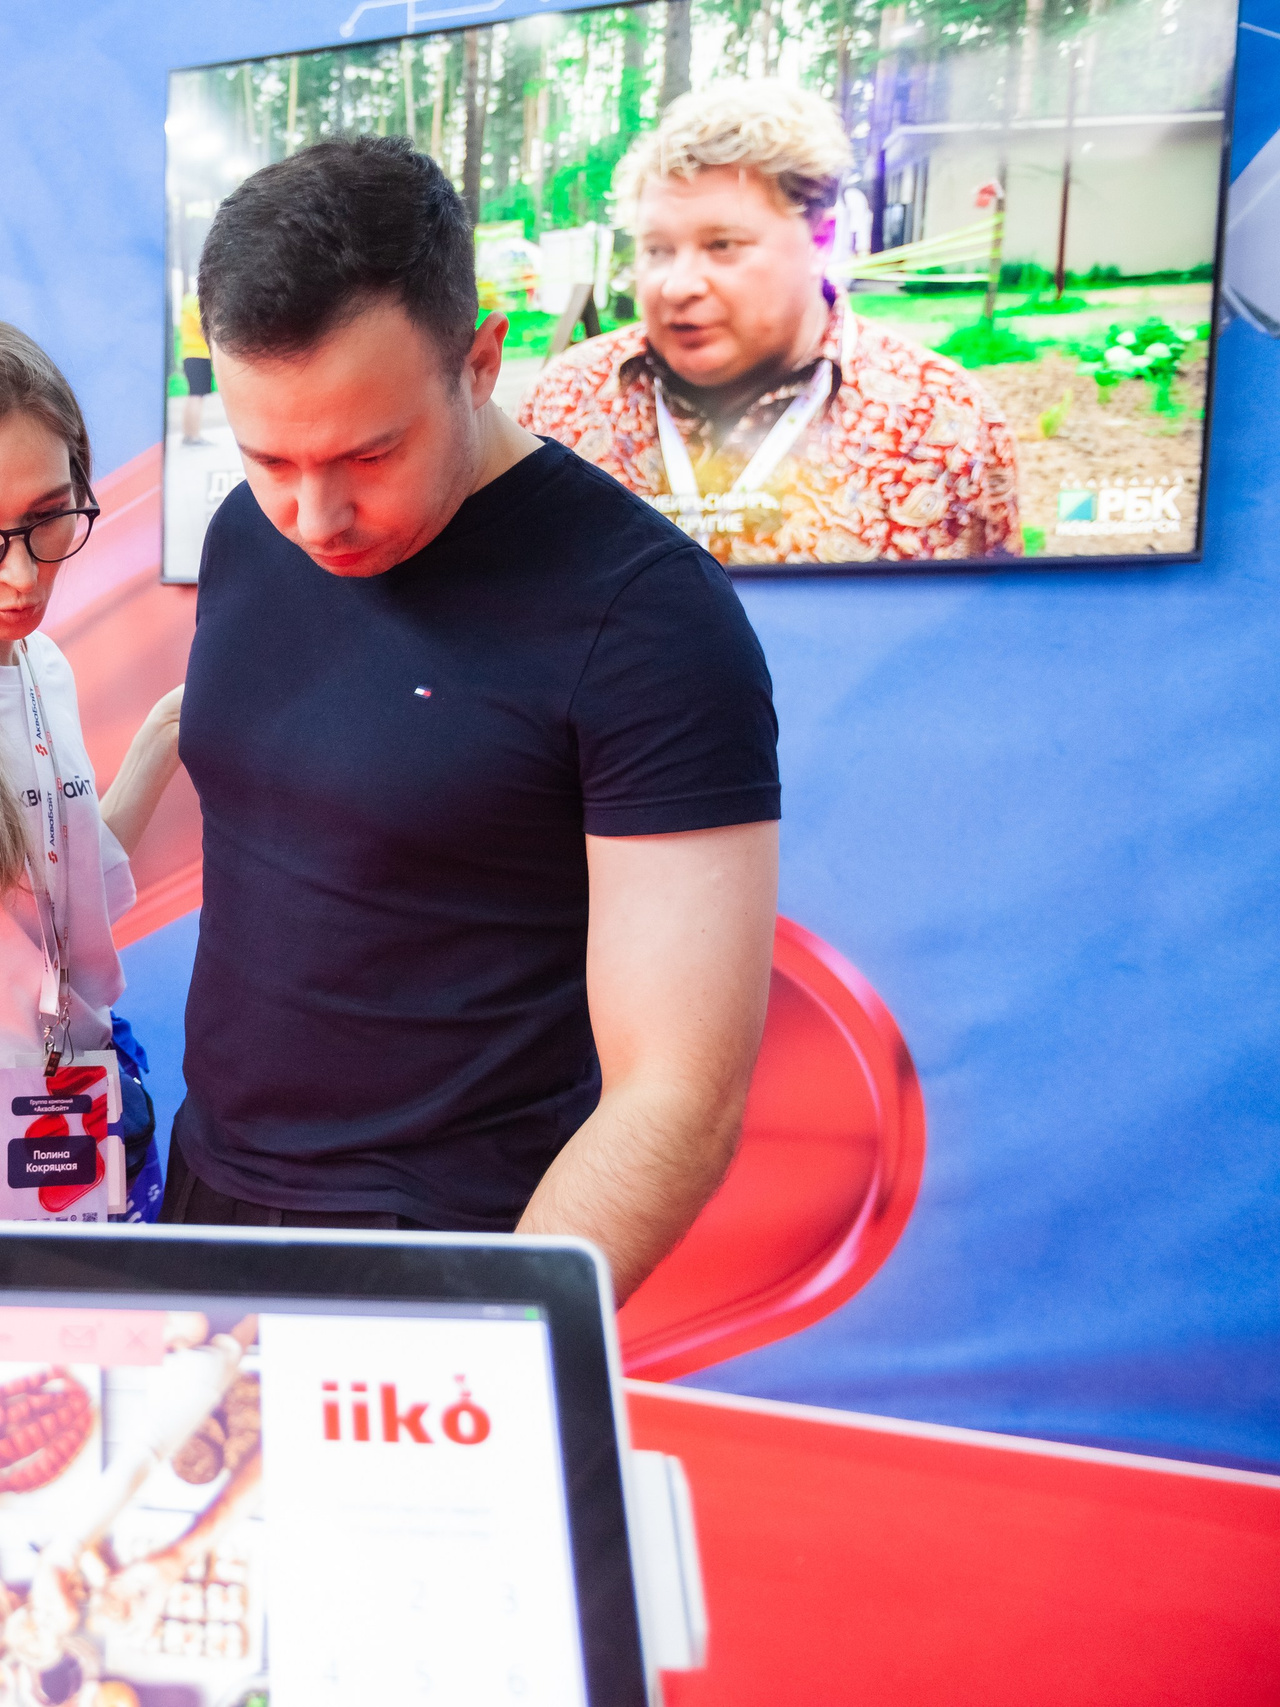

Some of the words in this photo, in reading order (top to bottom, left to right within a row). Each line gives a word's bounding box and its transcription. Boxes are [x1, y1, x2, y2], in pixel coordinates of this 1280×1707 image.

[1097, 486, 1183, 521] РБК
[33, 1150, 71, 1161] Полина
[25, 1162, 78, 1174] Кокряцкая
[321, 1373, 492, 1446] iiko
